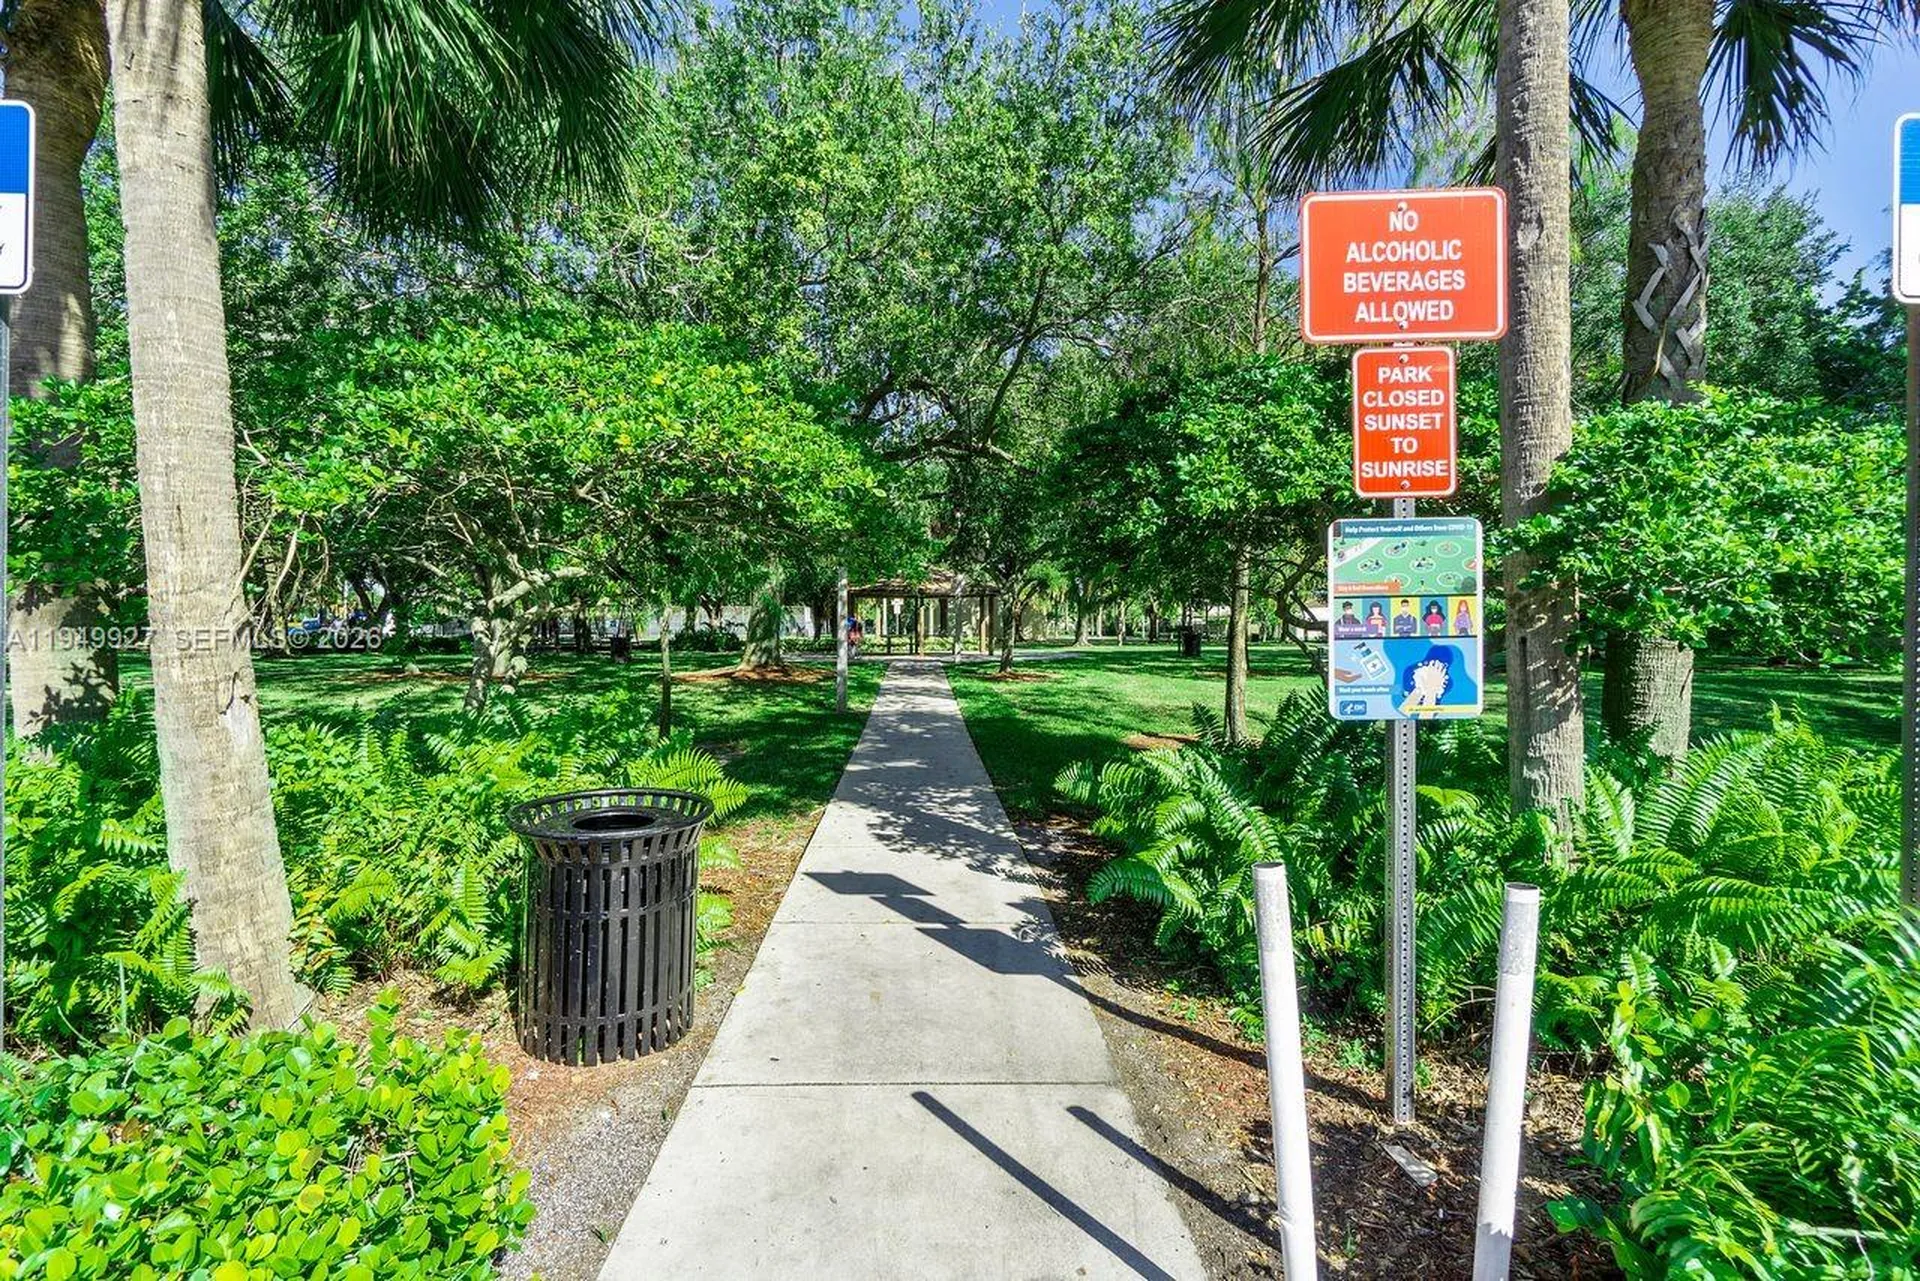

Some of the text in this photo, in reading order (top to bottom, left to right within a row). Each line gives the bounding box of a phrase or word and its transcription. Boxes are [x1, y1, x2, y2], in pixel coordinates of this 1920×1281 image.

[1389, 211, 1419, 232] NO
[1346, 239, 1462, 263] ALCOHOLIC
[1343, 270, 1466, 293] BEVERAGES
[1355, 300, 1454, 323] ALLOWED
[1377, 365, 1433, 384] PARK
[1362, 389, 1445, 408] CLOSED
[1364, 412, 1444, 431] SUNSET
[1390, 437, 1418, 454] TO
[1361, 460, 1448, 478] SUNRISE
